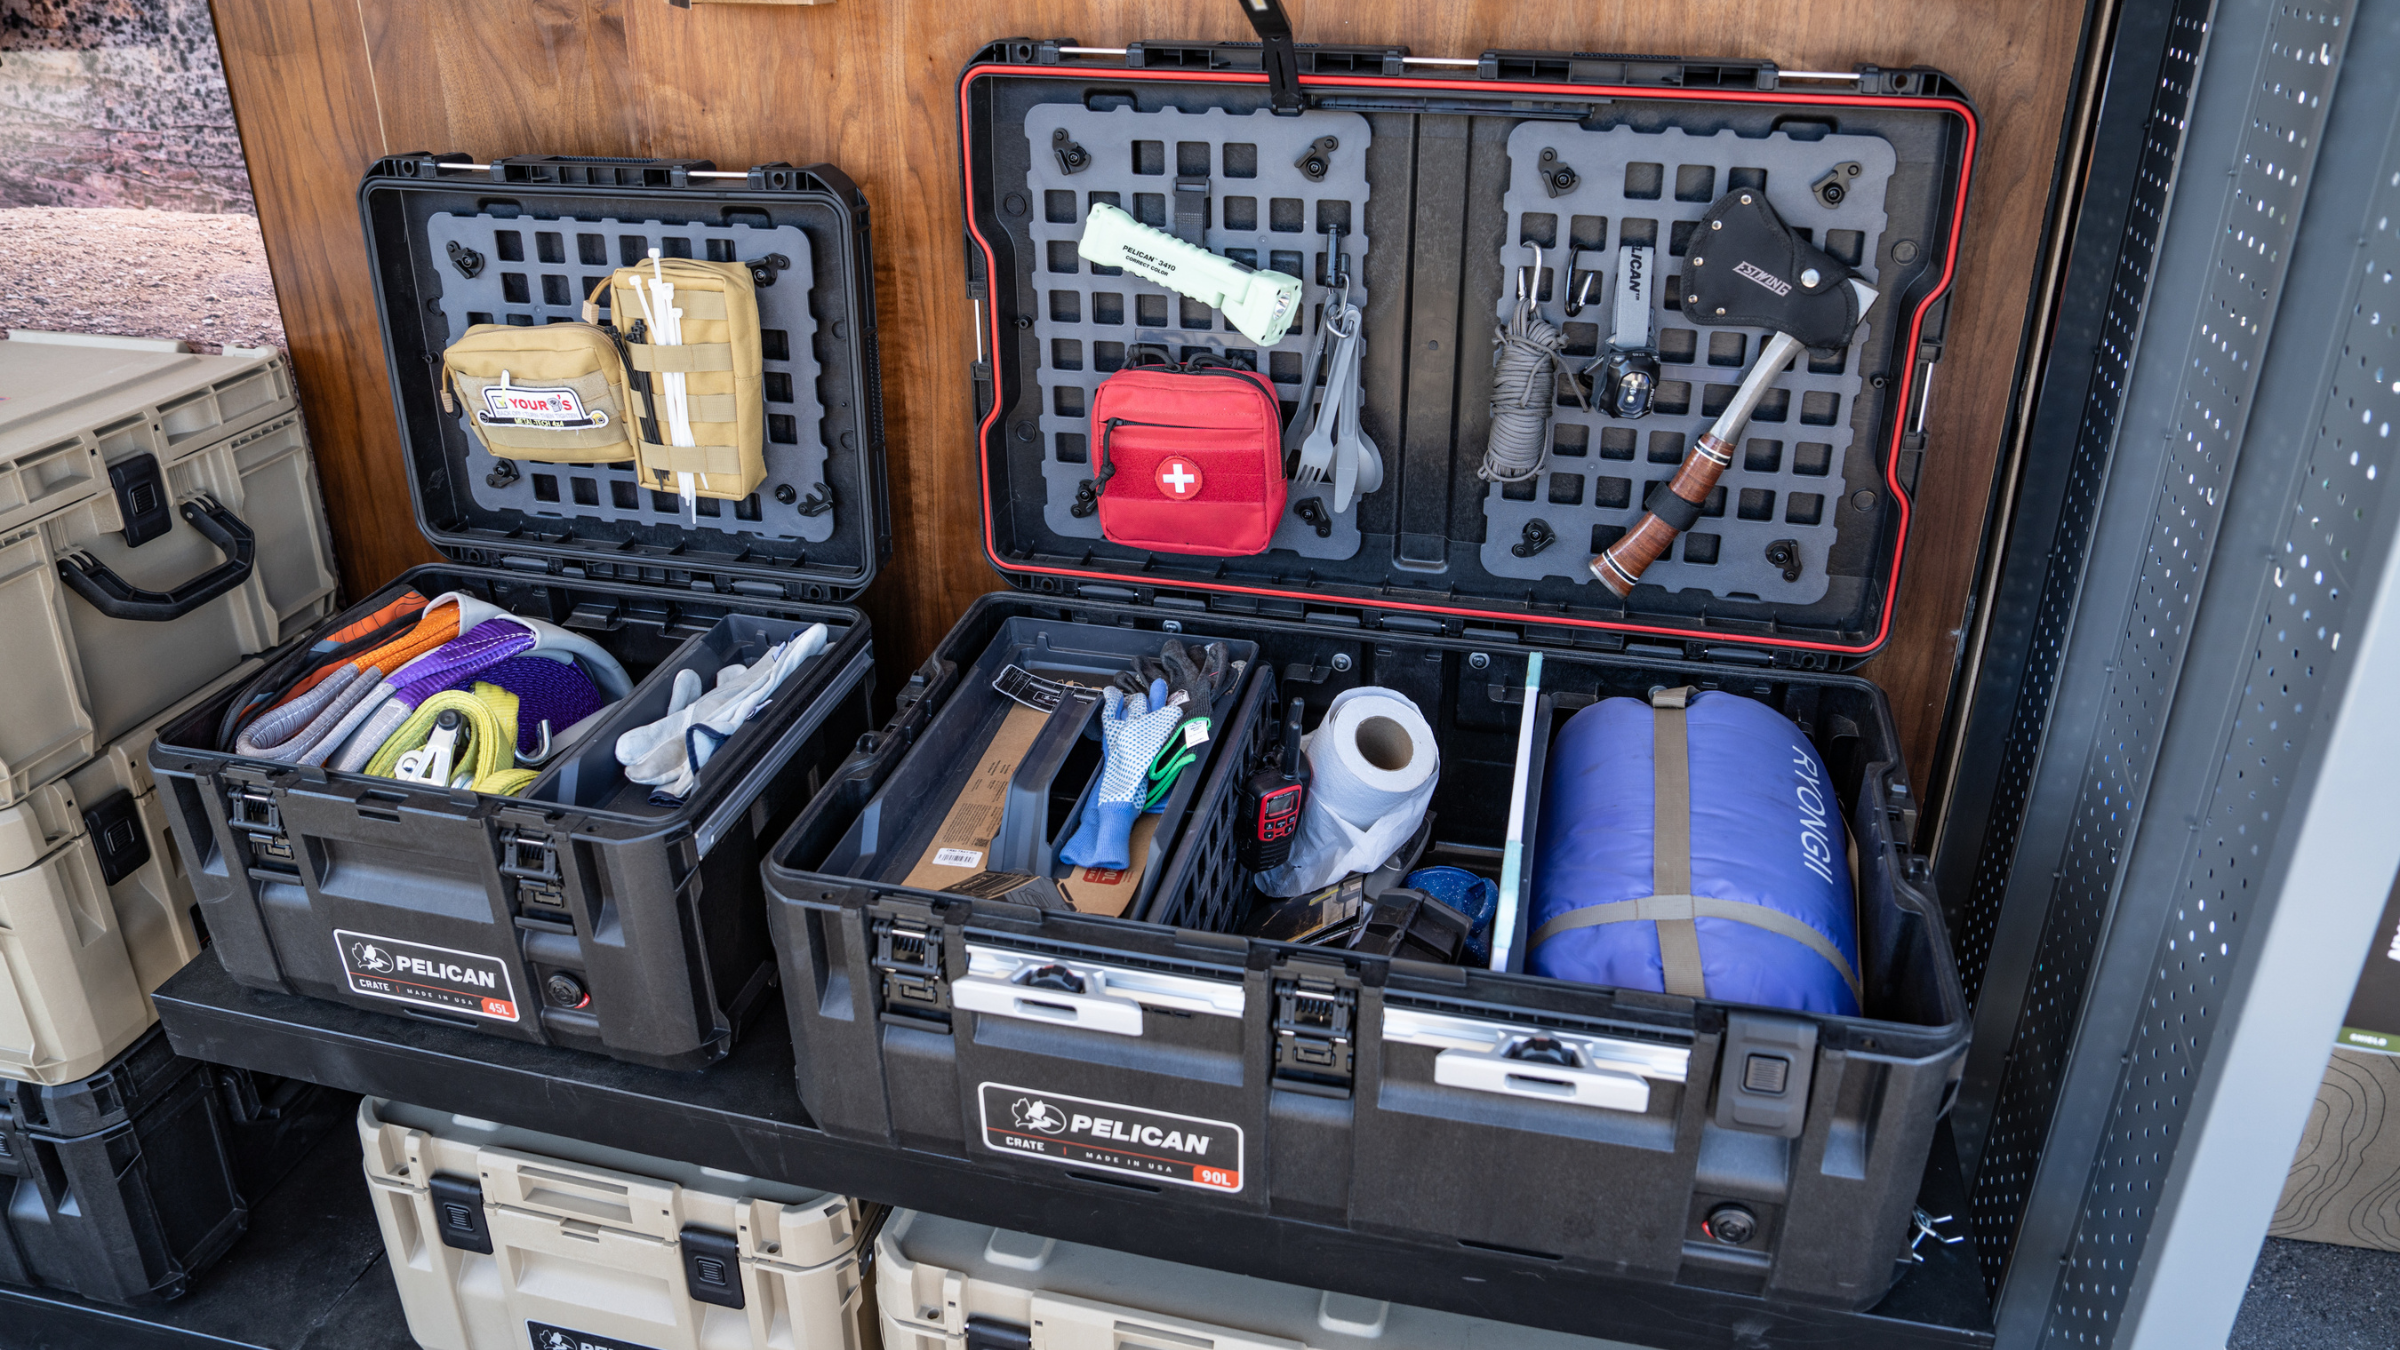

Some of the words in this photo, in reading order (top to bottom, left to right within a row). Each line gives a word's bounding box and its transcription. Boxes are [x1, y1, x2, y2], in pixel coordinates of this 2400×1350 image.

[1125, 255, 1150, 268] CORRECT
[1150, 266, 1169, 276] COLOR
[1158, 260, 1176, 271] 3410
[1732, 261, 1792, 297] ESTWING
[508, 398, 549, 411] YOUR
[1792, 745, 1833, 885] RYONGII
[395, 955, 496, 989] PELICAN
[359, 979, 390, 992] CRATE
[406, 988, 433, 998] MADE
[454, 997, 474, 1006] USA
[488, 1002, 510, 1015] 45L
[1070, 1114, 1210, 1155] PELICAN
[1005, 1136, 1045, 1152] CRATE
[1085, 1152, 1119, 1164] MADE
[1127, 1158, 1140, 1167] IN
[1148, 1162, 1173, 1174] USA
[1202, 1169, 1231, 1186] 90L
